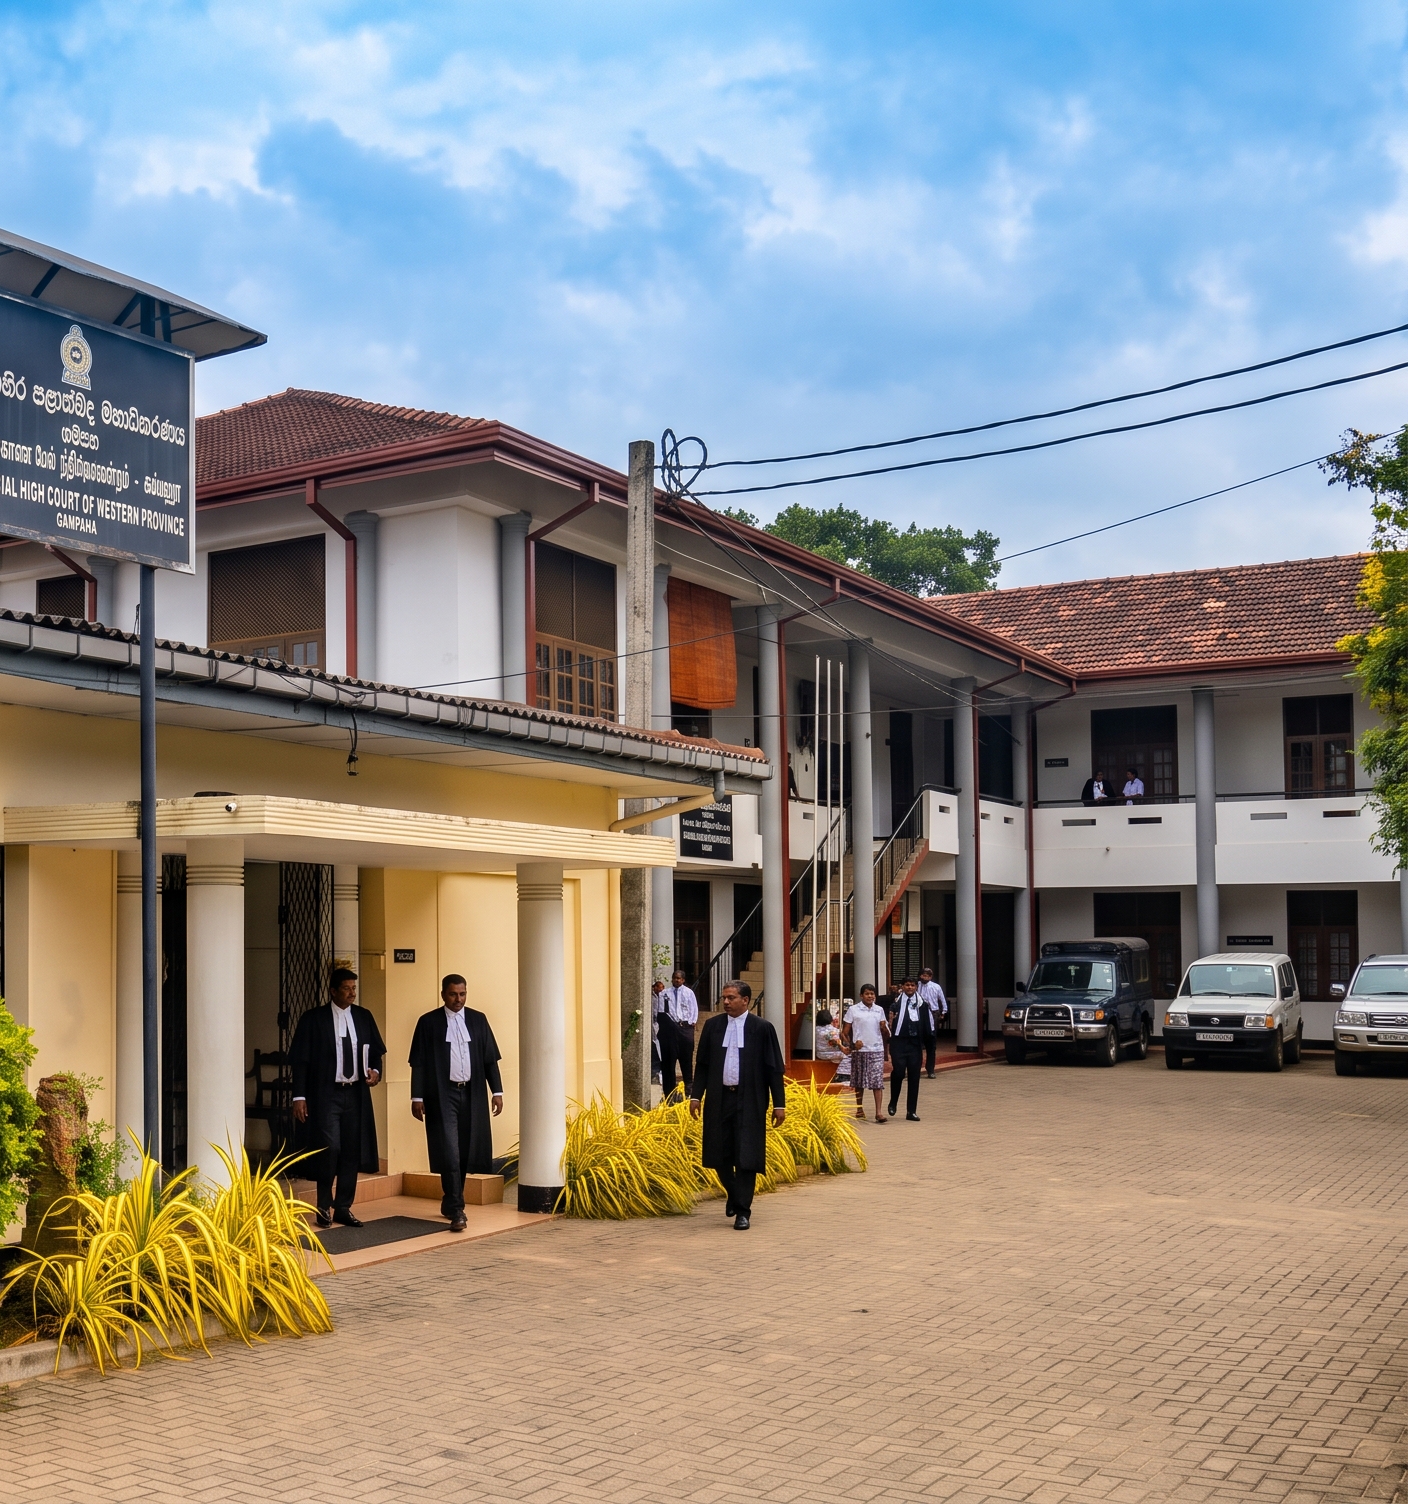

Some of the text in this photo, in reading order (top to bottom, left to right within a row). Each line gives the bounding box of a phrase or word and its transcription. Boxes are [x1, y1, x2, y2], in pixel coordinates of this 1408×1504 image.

[20, 480, 44, 503] HIGH
[48, 486, 80, 511] COURT
[83, 494, 94, 514] OF
[97, 498, 139, 525] WESTERN
[142, 508, 184, 536] PROVINCE
[57, 513, 97, 535] GAMPAHA
